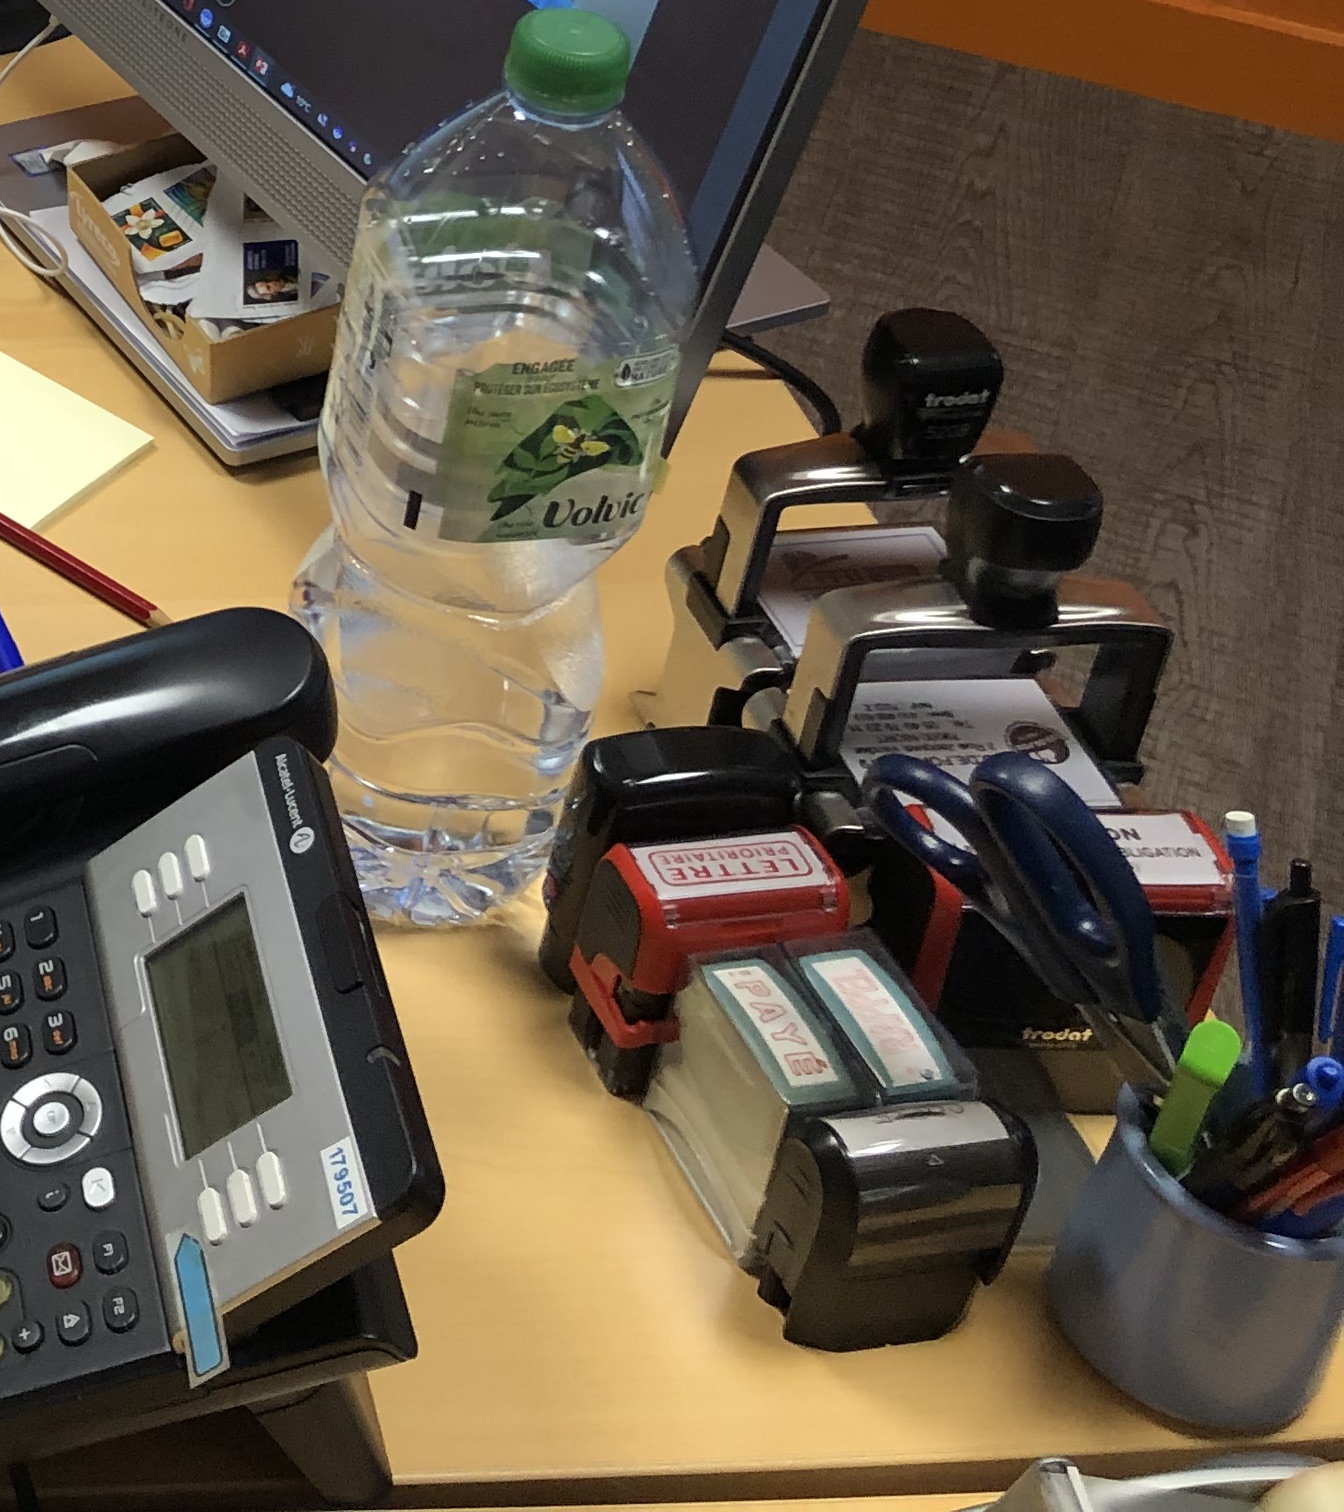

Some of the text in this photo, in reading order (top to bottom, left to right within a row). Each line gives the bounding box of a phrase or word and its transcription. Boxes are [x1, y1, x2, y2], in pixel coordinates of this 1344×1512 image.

[924, 388, 991, 408] trodat
[543, 491, 645, 529] Volvic
[275, 753, 304, 829] Alcatel-Lucent
[657, 845, 791, 866] PRIORITAIRE
[665, 857, 800, 881] LETTRE
[30, 911, 44, 922] 1
[38, 959, 54, 976] 2
[47, 1012, 63, 1028] 3
[733, 979, 829, 1077] PAYÉ
[3, 1026, 19, 1042] 6
[1022, 1026, 1094, 1041] trodat
[329, 1146, 359, 1216] 179507
[112, 1296, 125, 1316] F2
